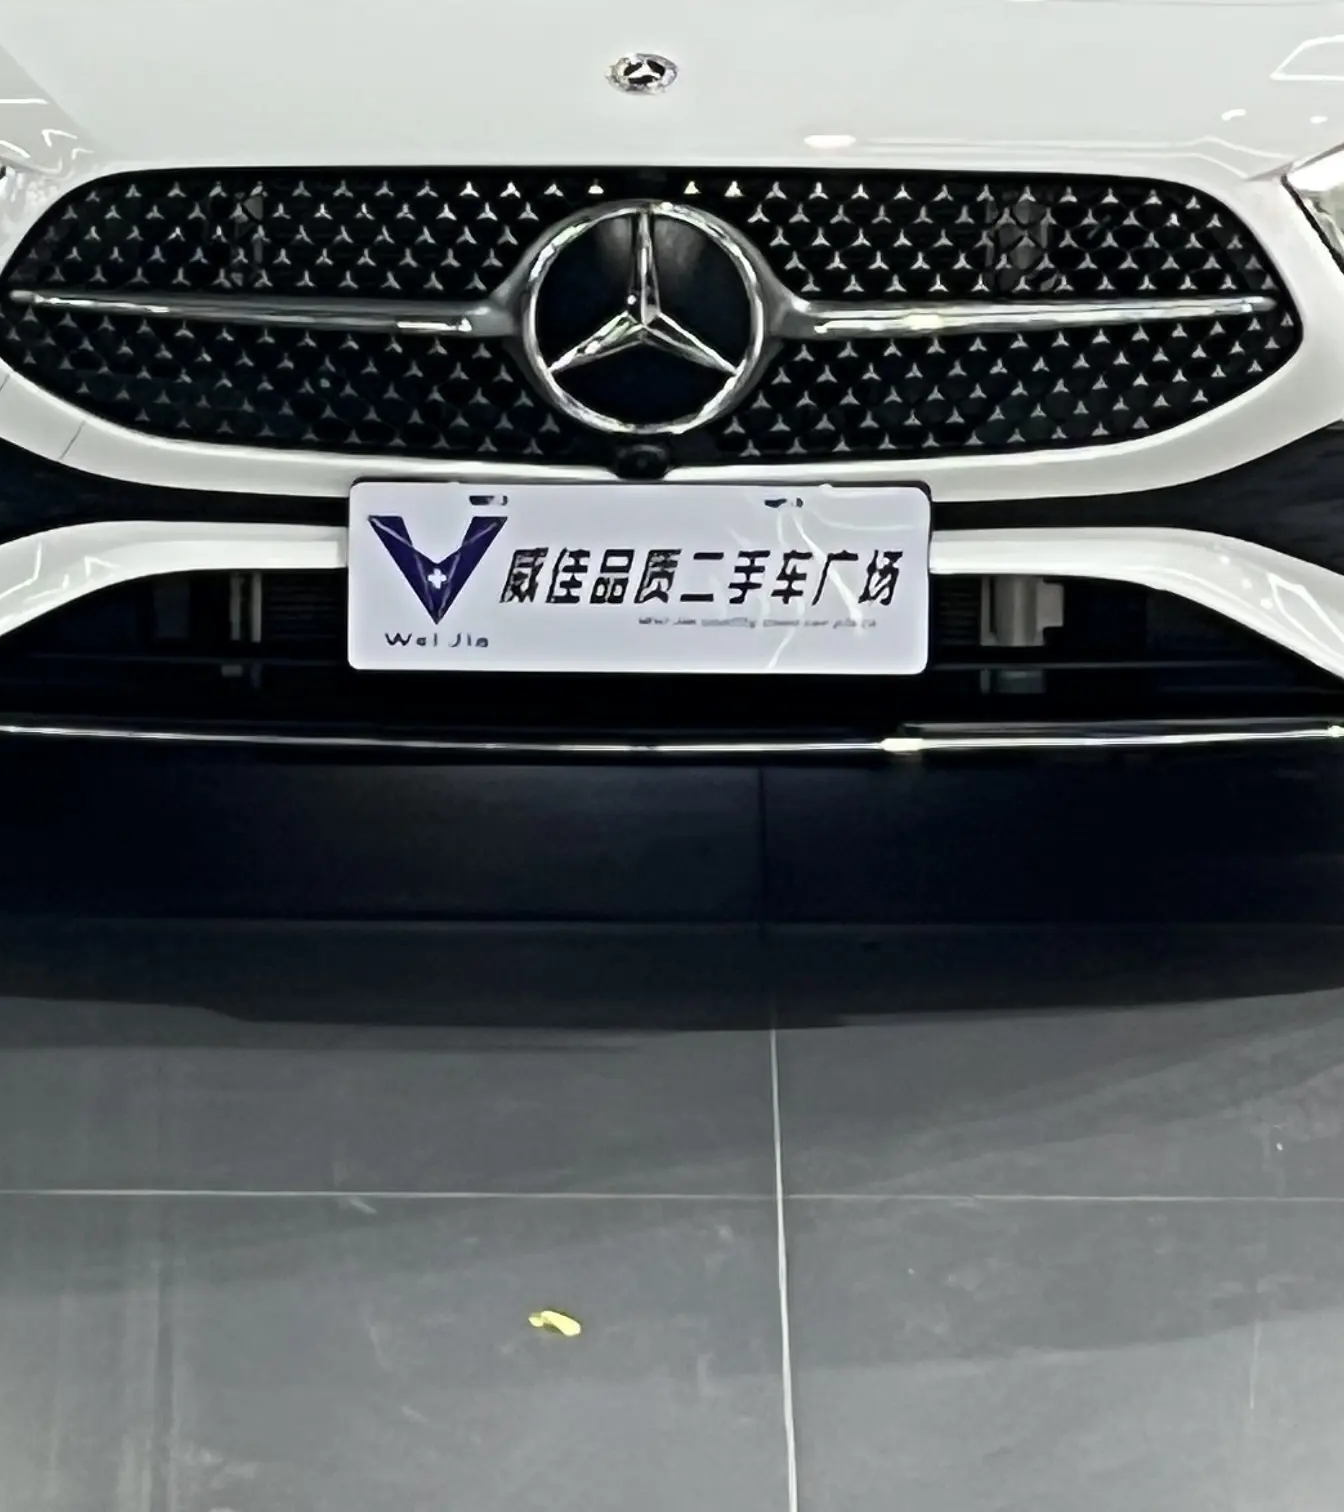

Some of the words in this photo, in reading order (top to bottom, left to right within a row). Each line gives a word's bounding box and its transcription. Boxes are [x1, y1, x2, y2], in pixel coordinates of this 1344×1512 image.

[499, 546, 905, 606] 威佳品质二手车广场
